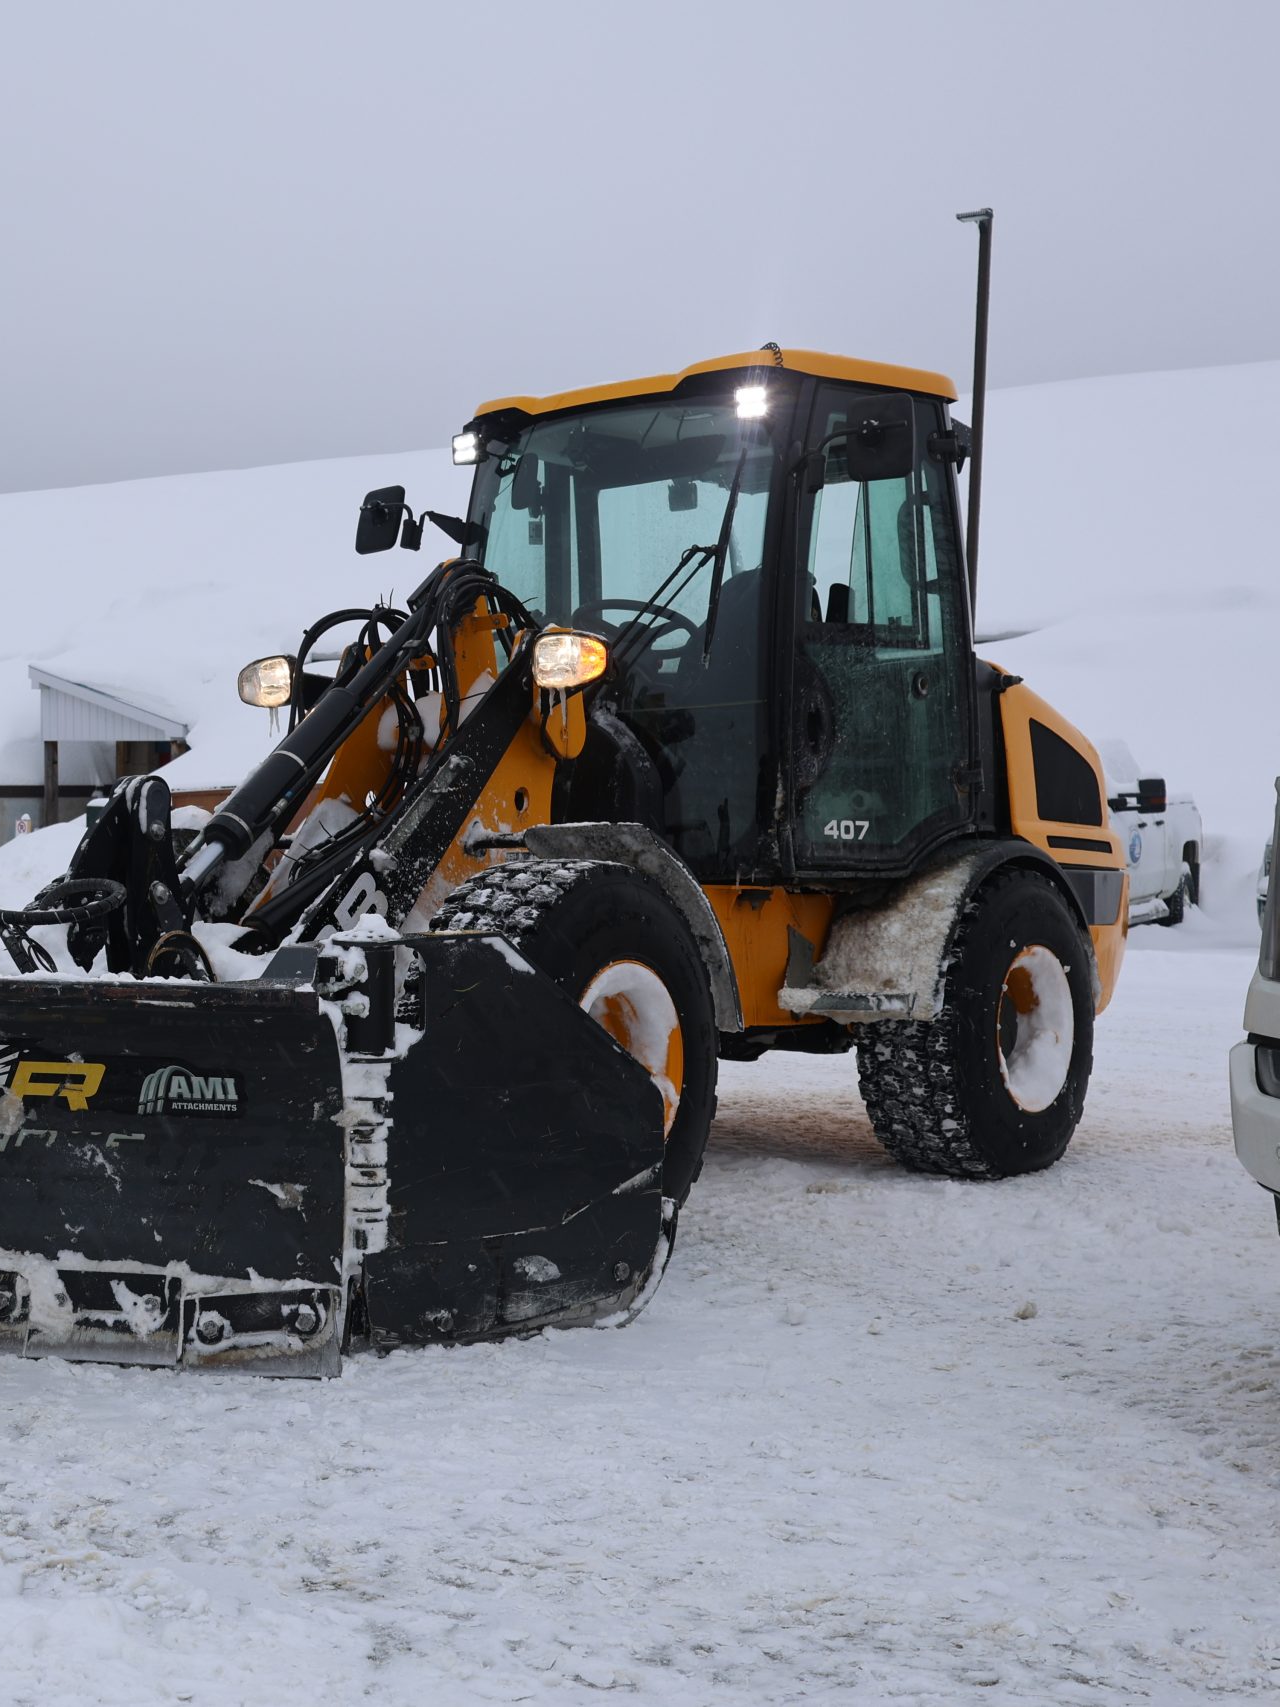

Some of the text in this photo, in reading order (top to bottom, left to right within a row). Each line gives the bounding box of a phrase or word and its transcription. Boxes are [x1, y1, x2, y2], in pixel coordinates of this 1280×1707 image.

[823, 819, 870, 840] 407
[168, 1075, 239, 1100] AMI
[171, 1101, 238, 1112] ATTACHMENTS
